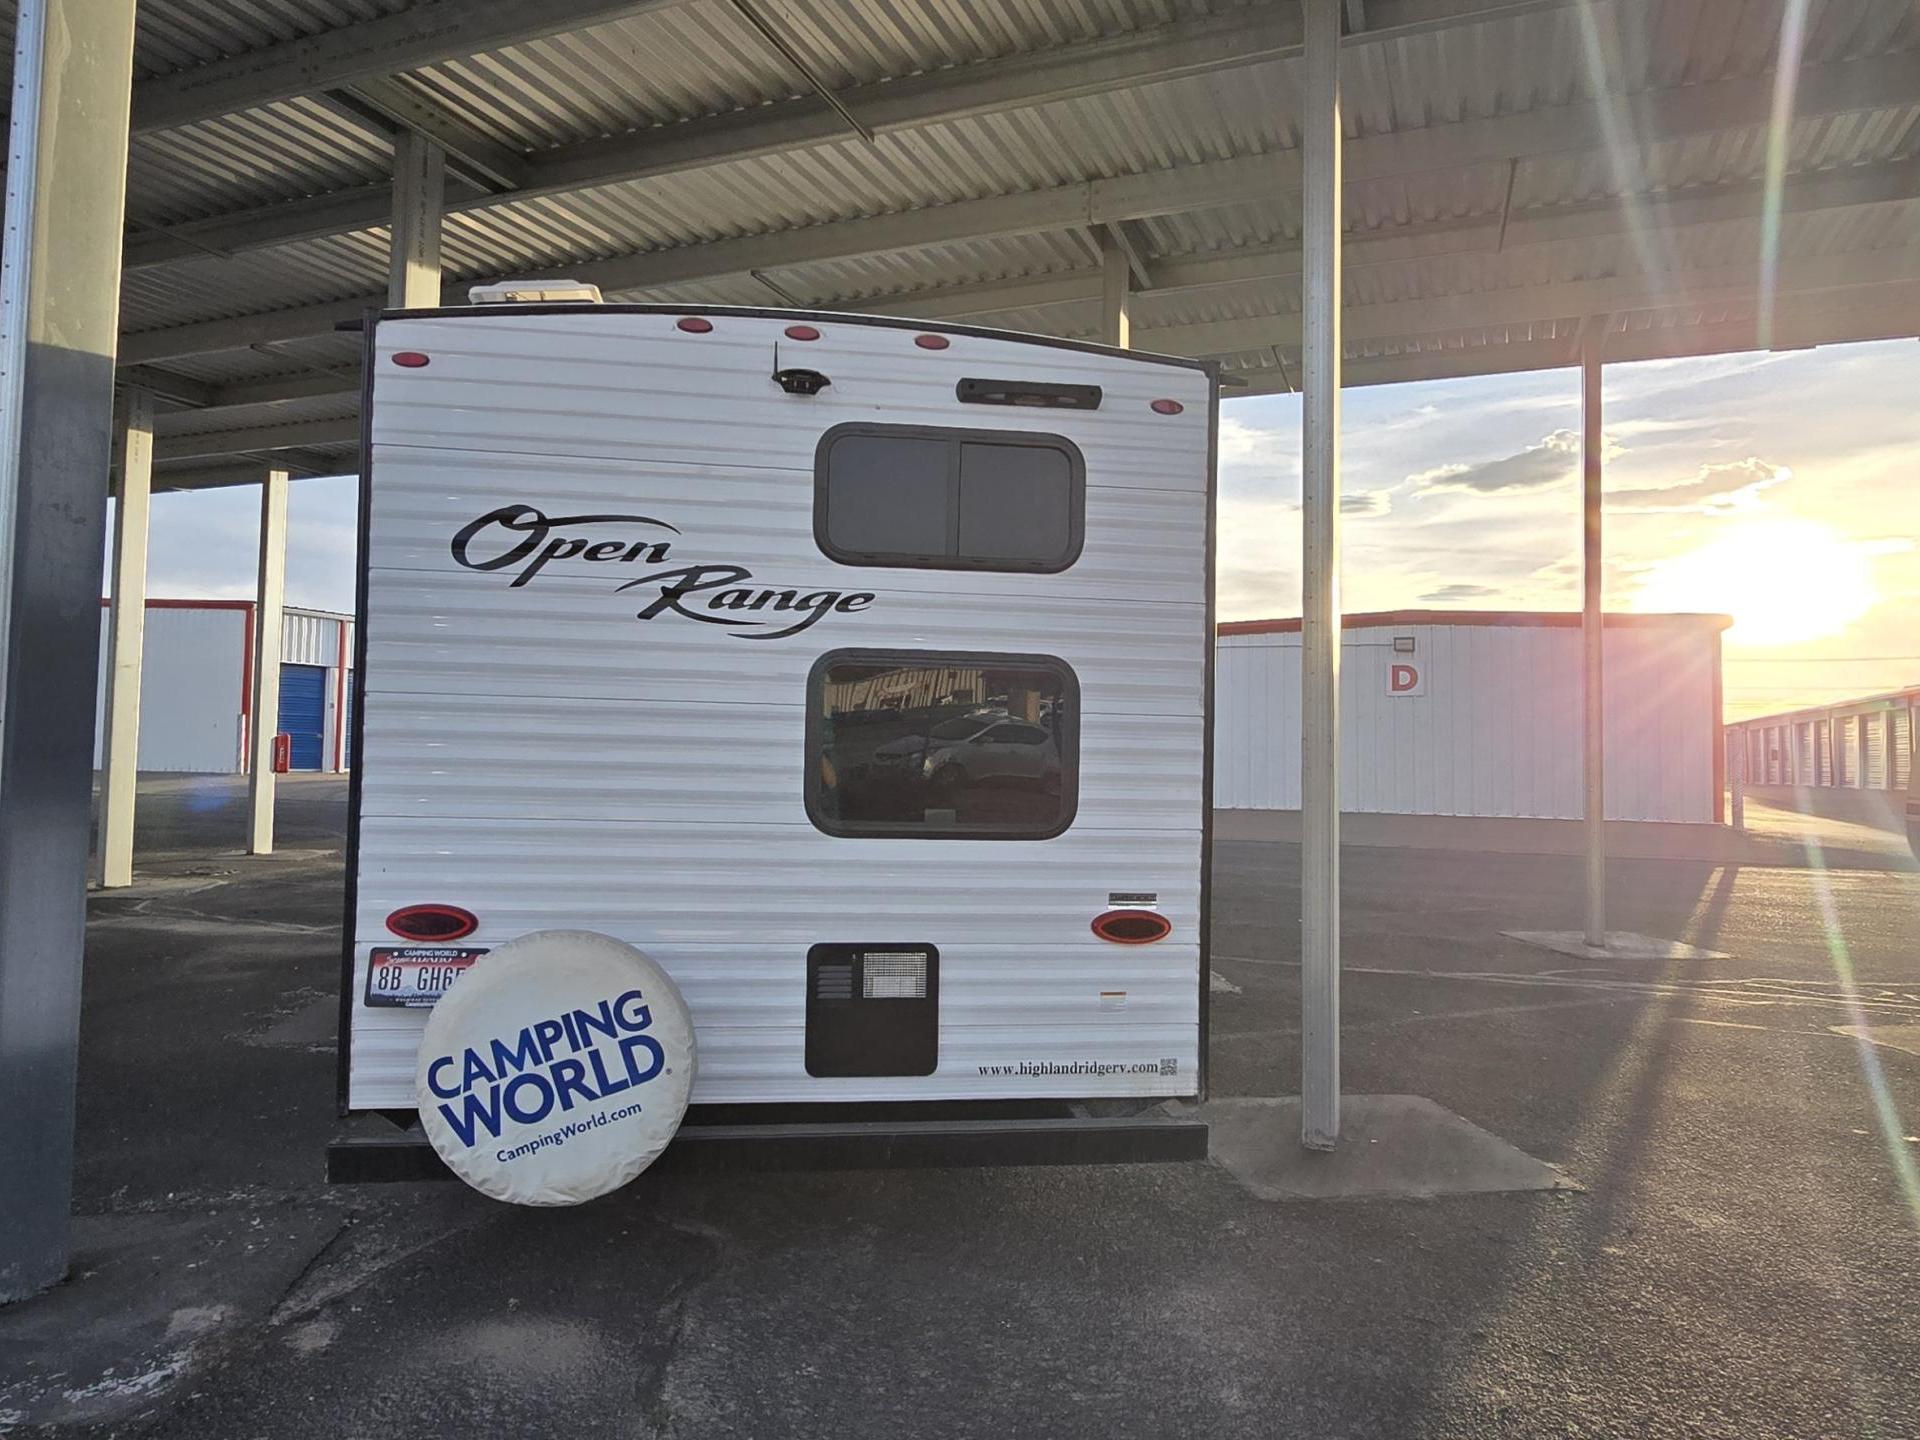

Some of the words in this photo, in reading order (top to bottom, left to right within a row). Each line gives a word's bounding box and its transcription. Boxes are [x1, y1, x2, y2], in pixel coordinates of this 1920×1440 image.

[451, 504, 681, 588] Open
[614, 564, 876, 640] Range
[1391, 664, 1419, 692] D
[378, 966, 402, 991] 8B
[404, 949, 433, 957] CAMPING
[427, 989, 653, 1099] CAMPING
[978, 1060, 1159, 1078] www.highlandridgerv.com
[437, 1034, 665, 1148] WORLD
[496, 1102, 642, 1163] CampingWorld.com
